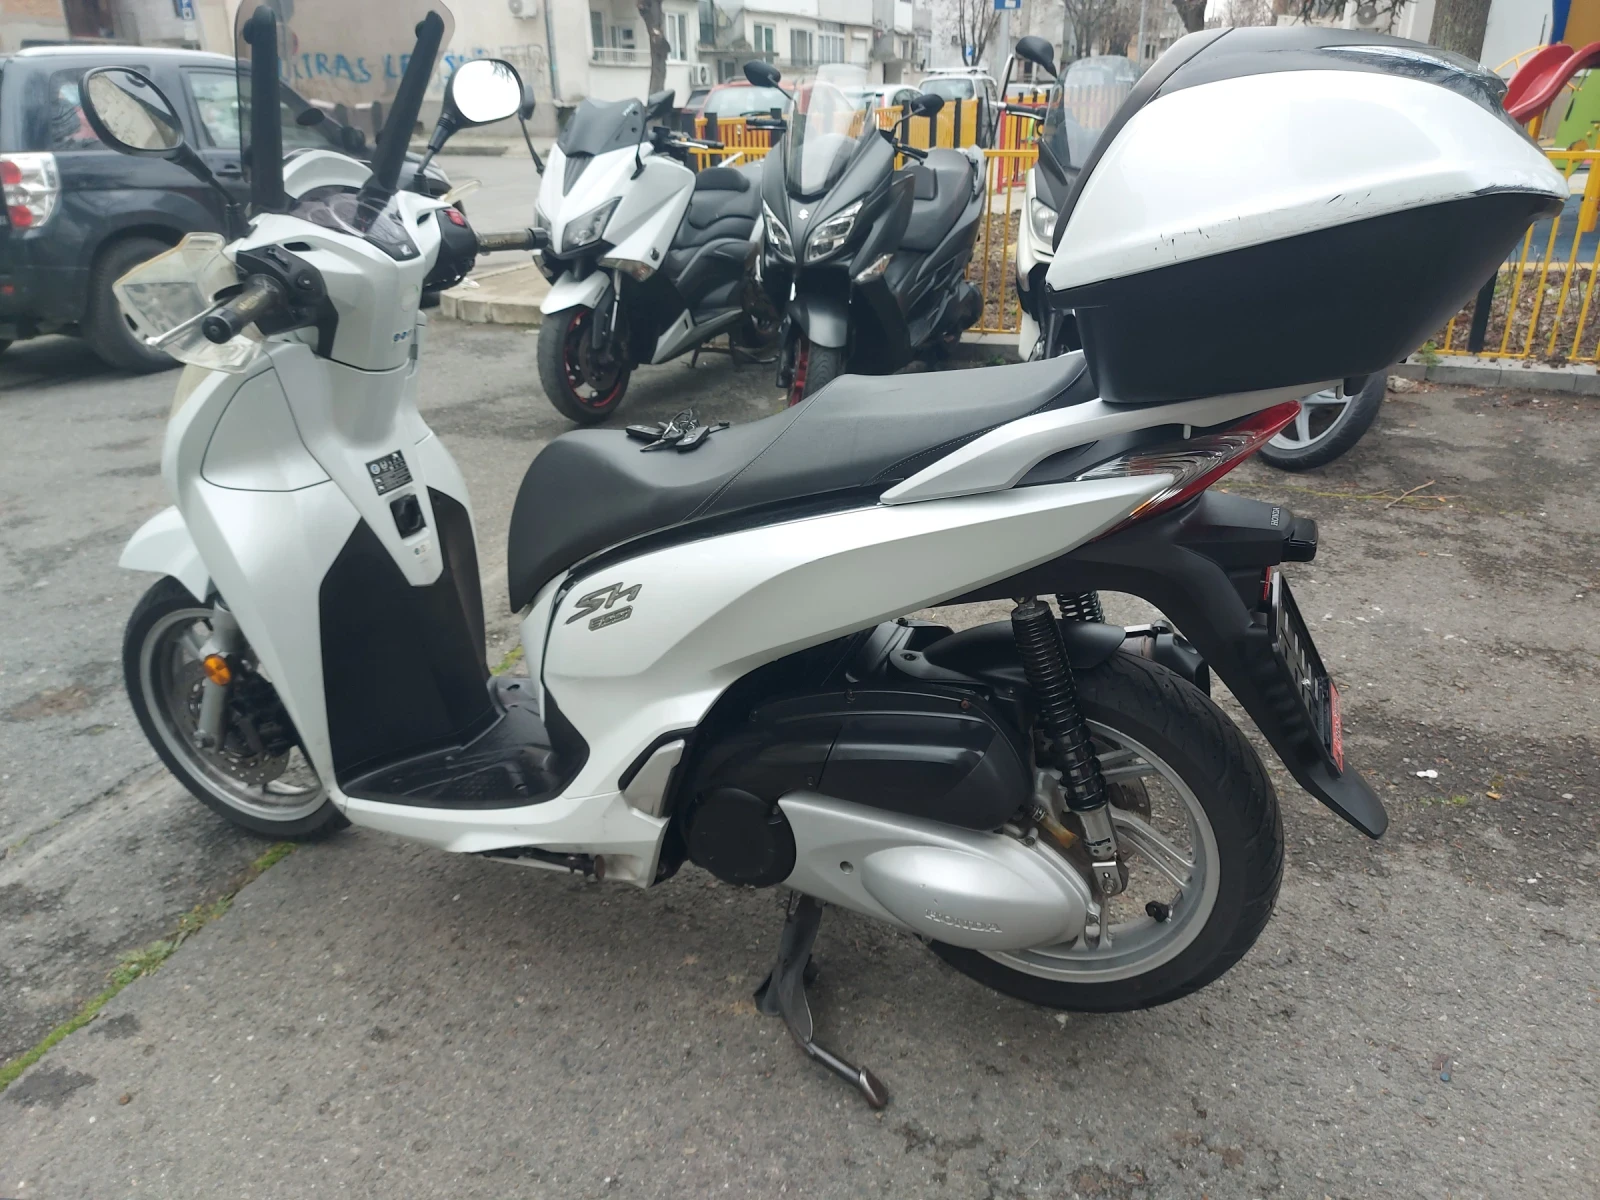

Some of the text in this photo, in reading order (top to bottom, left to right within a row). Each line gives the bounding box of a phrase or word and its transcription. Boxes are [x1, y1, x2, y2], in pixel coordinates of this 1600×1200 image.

[1270, 507, 1280, 527] HONDA
[564, 581, 643, 625] SH
[925, 909, 1003, 933] HONDA
